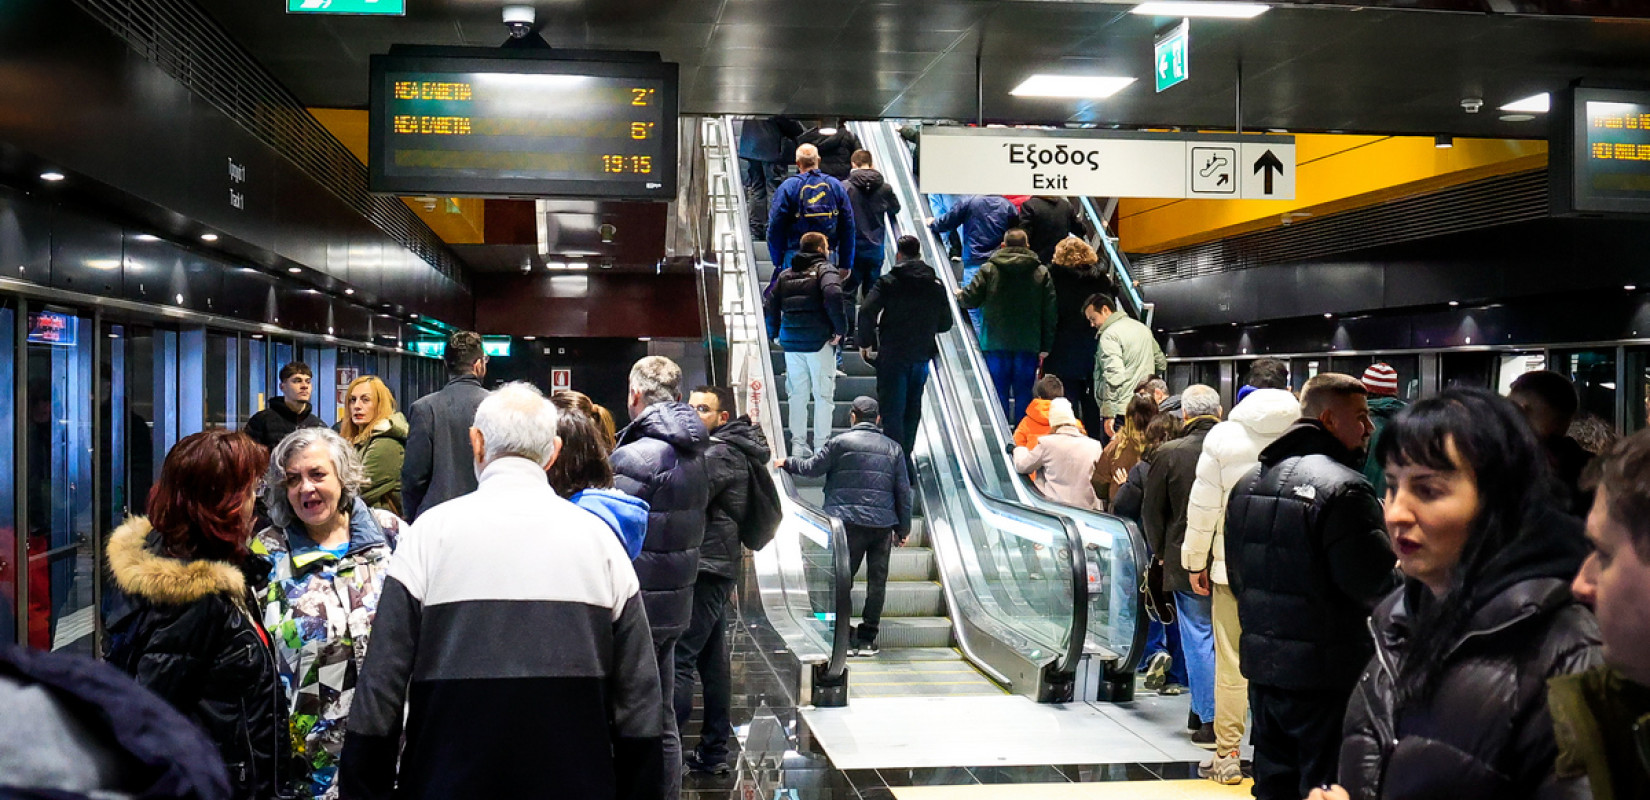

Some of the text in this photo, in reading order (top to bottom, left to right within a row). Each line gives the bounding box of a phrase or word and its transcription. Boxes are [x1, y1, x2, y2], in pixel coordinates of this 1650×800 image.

[602, 155, 652, 173] 19:15
[1002, 143, 1099, 171] Έξοδος
[1033, 173, 1068, 190] Exit
